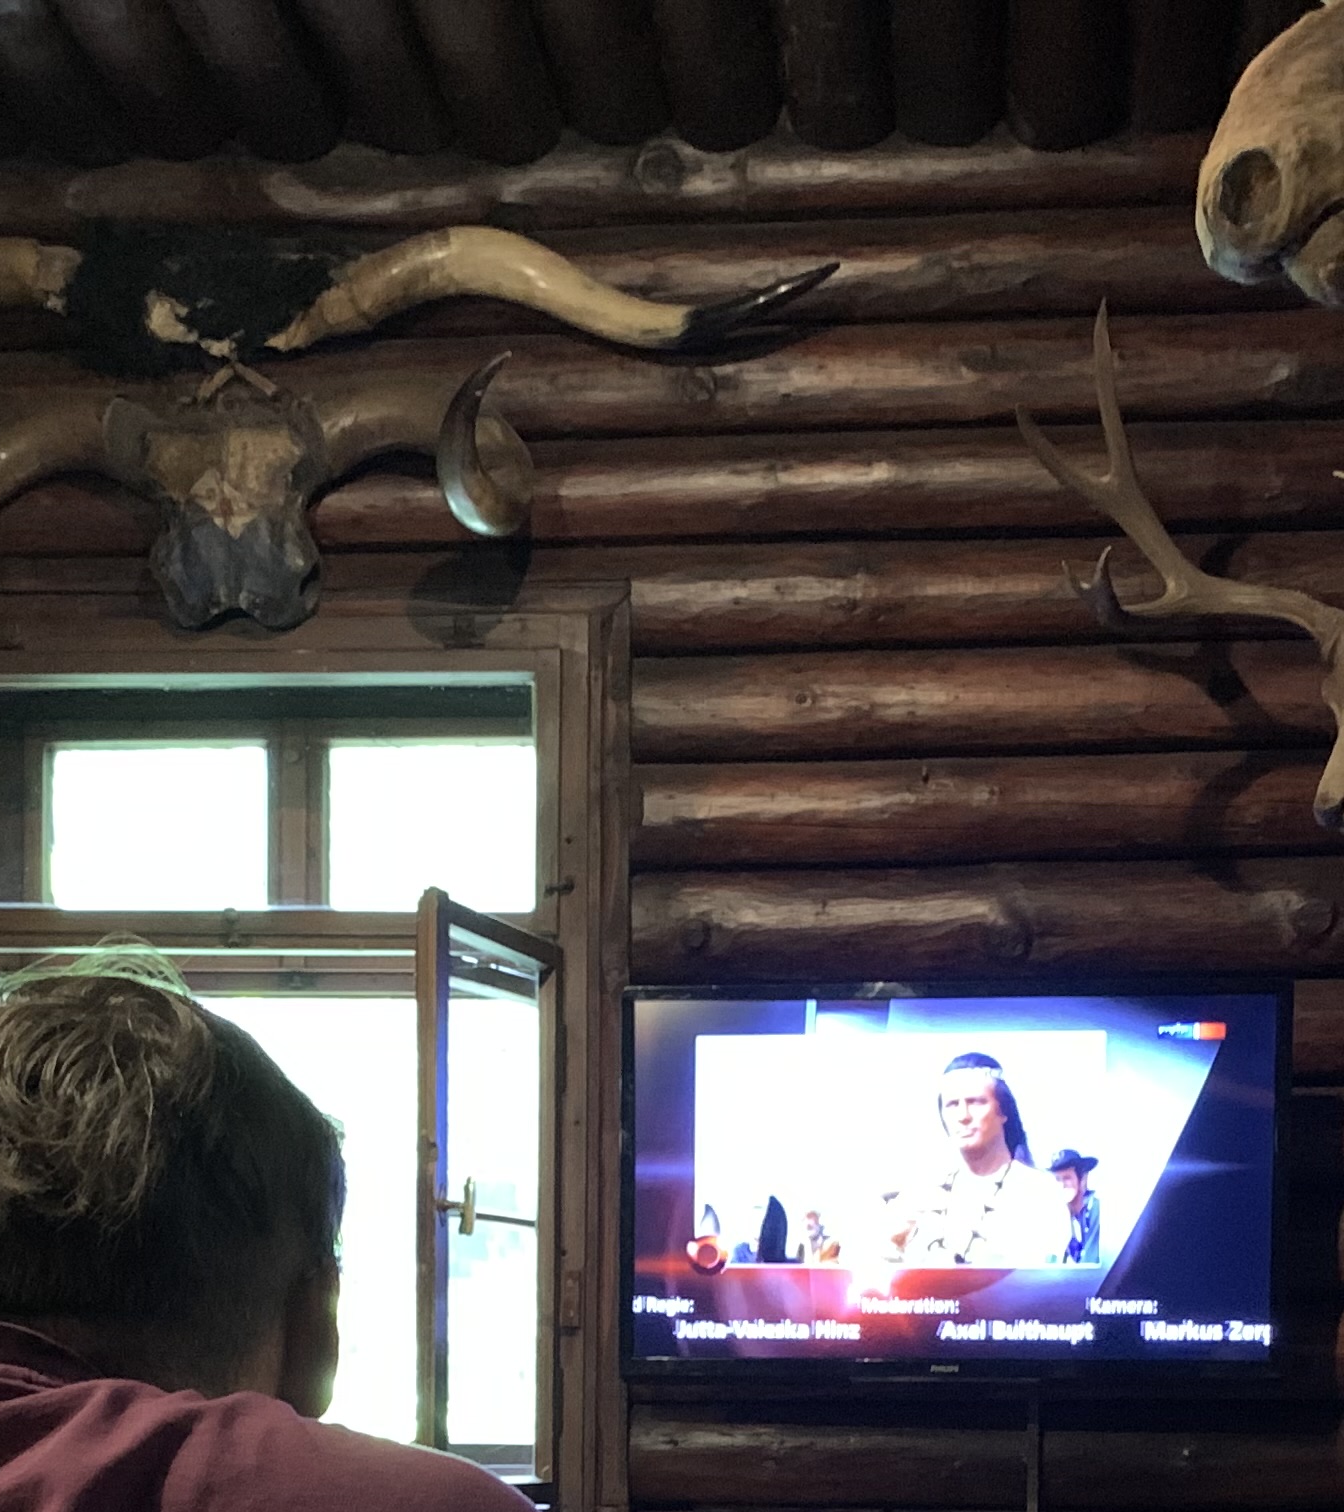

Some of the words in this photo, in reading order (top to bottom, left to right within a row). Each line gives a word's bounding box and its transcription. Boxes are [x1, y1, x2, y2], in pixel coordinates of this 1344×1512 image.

[646, 1296, 695, 1317] Regie:
[860, 1296, 960, 1314] Moderation:
[1089, 1298, 1158, 1314] Kamera:
[940, 1319, 986, 1340] Axel
[992, 1319, 1094, 1345] Bulthaupt
[1144, 1320, 1223, 1341] Markus
